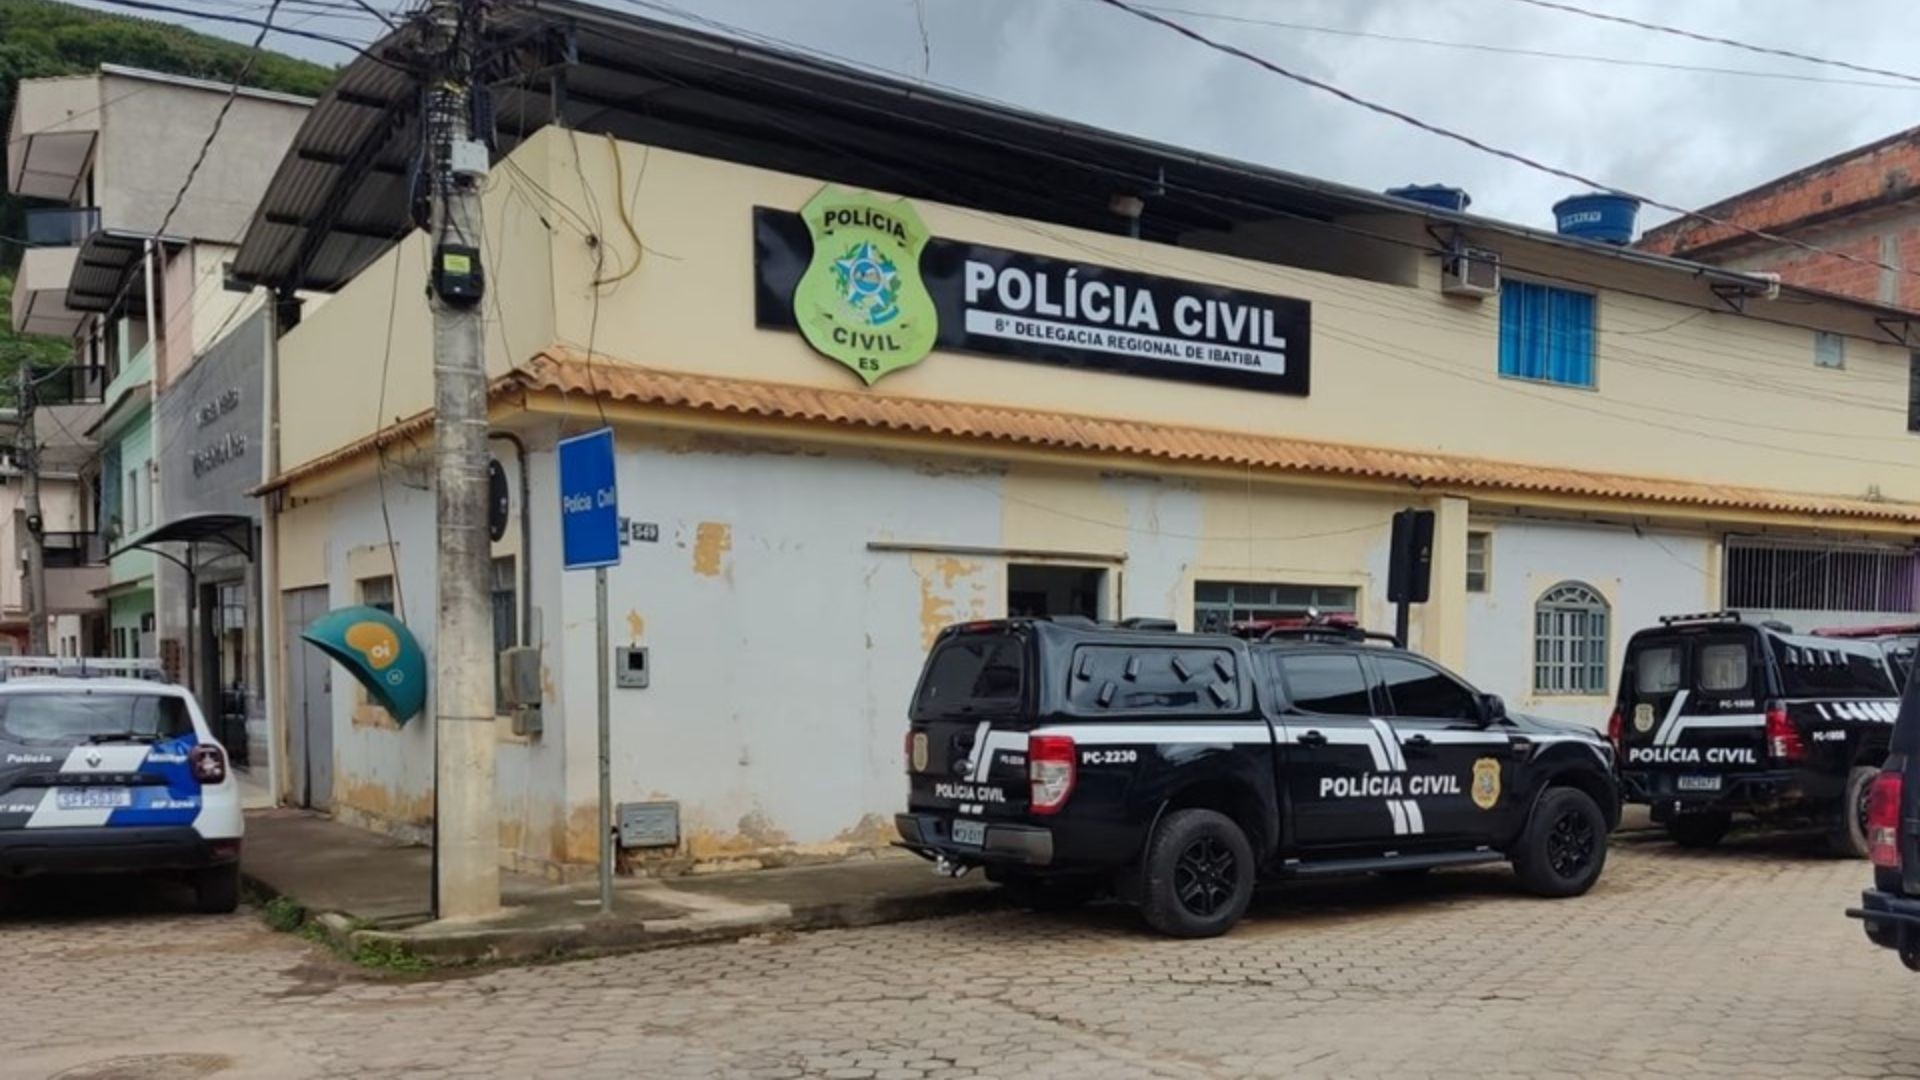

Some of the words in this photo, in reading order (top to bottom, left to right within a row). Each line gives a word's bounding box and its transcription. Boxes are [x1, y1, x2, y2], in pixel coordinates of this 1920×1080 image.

[824, 206, 907, 241] POLÍCIA
[965, 260, 1160, 330] POLÍCIA
[1173, 296, 1287, 349] CIVIL
[833, 327, 901, 351] CIVIL
[1015, 321, 1103, 347] DELEGACIA
[1107, 335, 1181, 358] REGIONAL
[1185, 345, 1204, 360] DE
[1208, 348, 1262, 368] IBATIBA
[858, 357, 880, 371] ES
[371, 640, 391, 659] oi
[1082, 750, 1138, 764] PC-2230
[1705, 747, 1757, 764] CIVIL
[977, 787, 1006, 803] CIVIL
[1320, 772, 1403, 797] POLÍCIA
[1409, 775, 1461, 795] CIVIL
